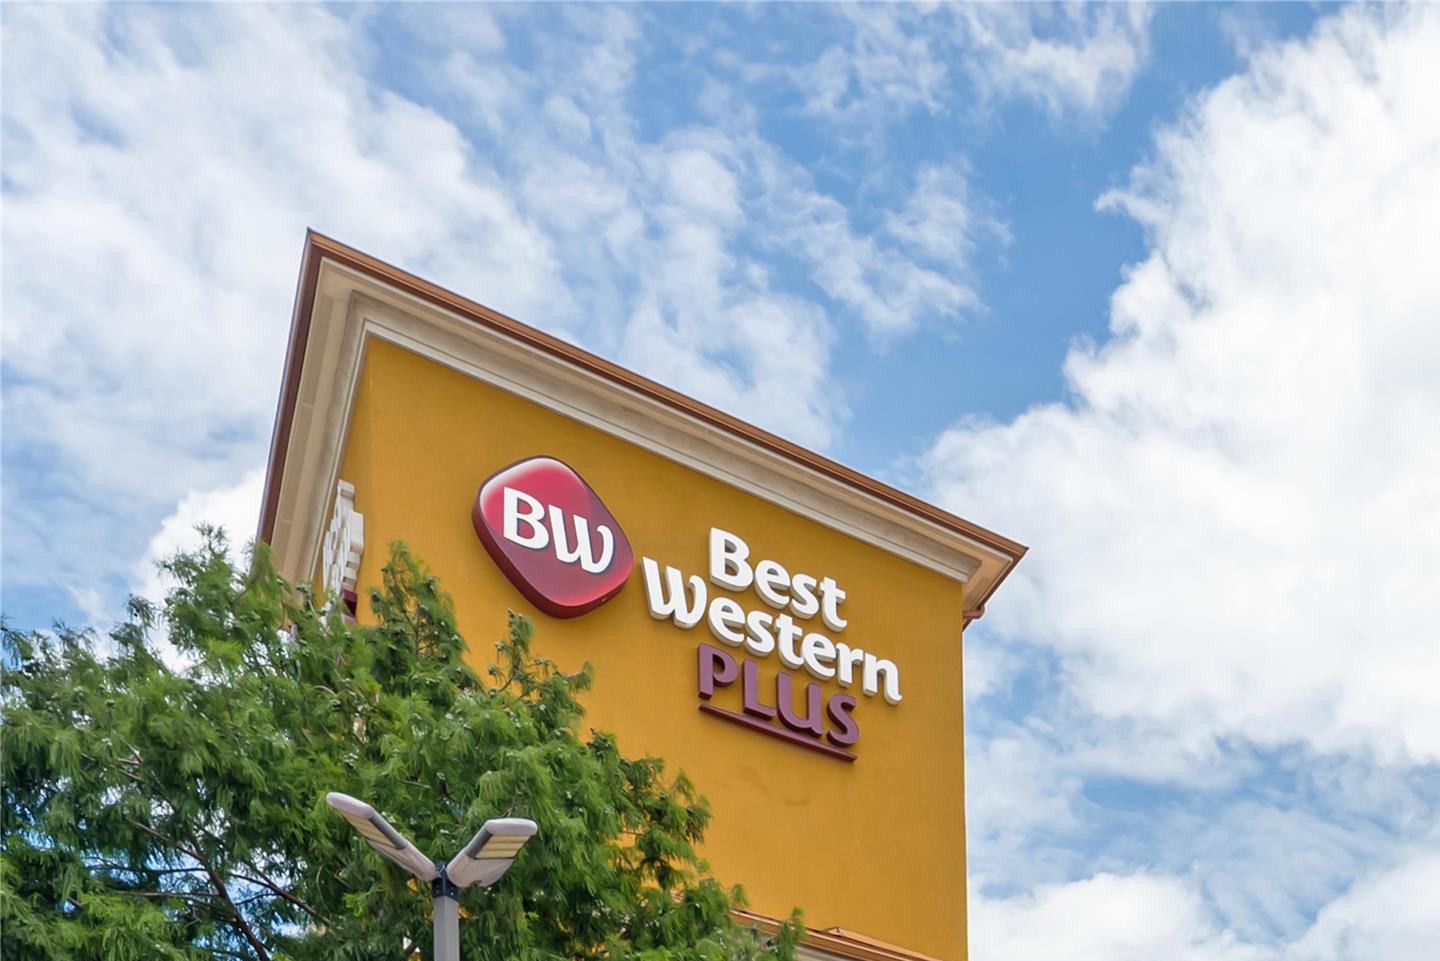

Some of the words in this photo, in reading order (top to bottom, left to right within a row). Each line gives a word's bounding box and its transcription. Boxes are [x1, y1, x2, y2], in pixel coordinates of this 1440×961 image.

[503, 486, 614, 574] BW
[708, 527, 848, 632] Best
[642, 556, 903, 705] Western
[697, 642, 860, 747] PLUS
